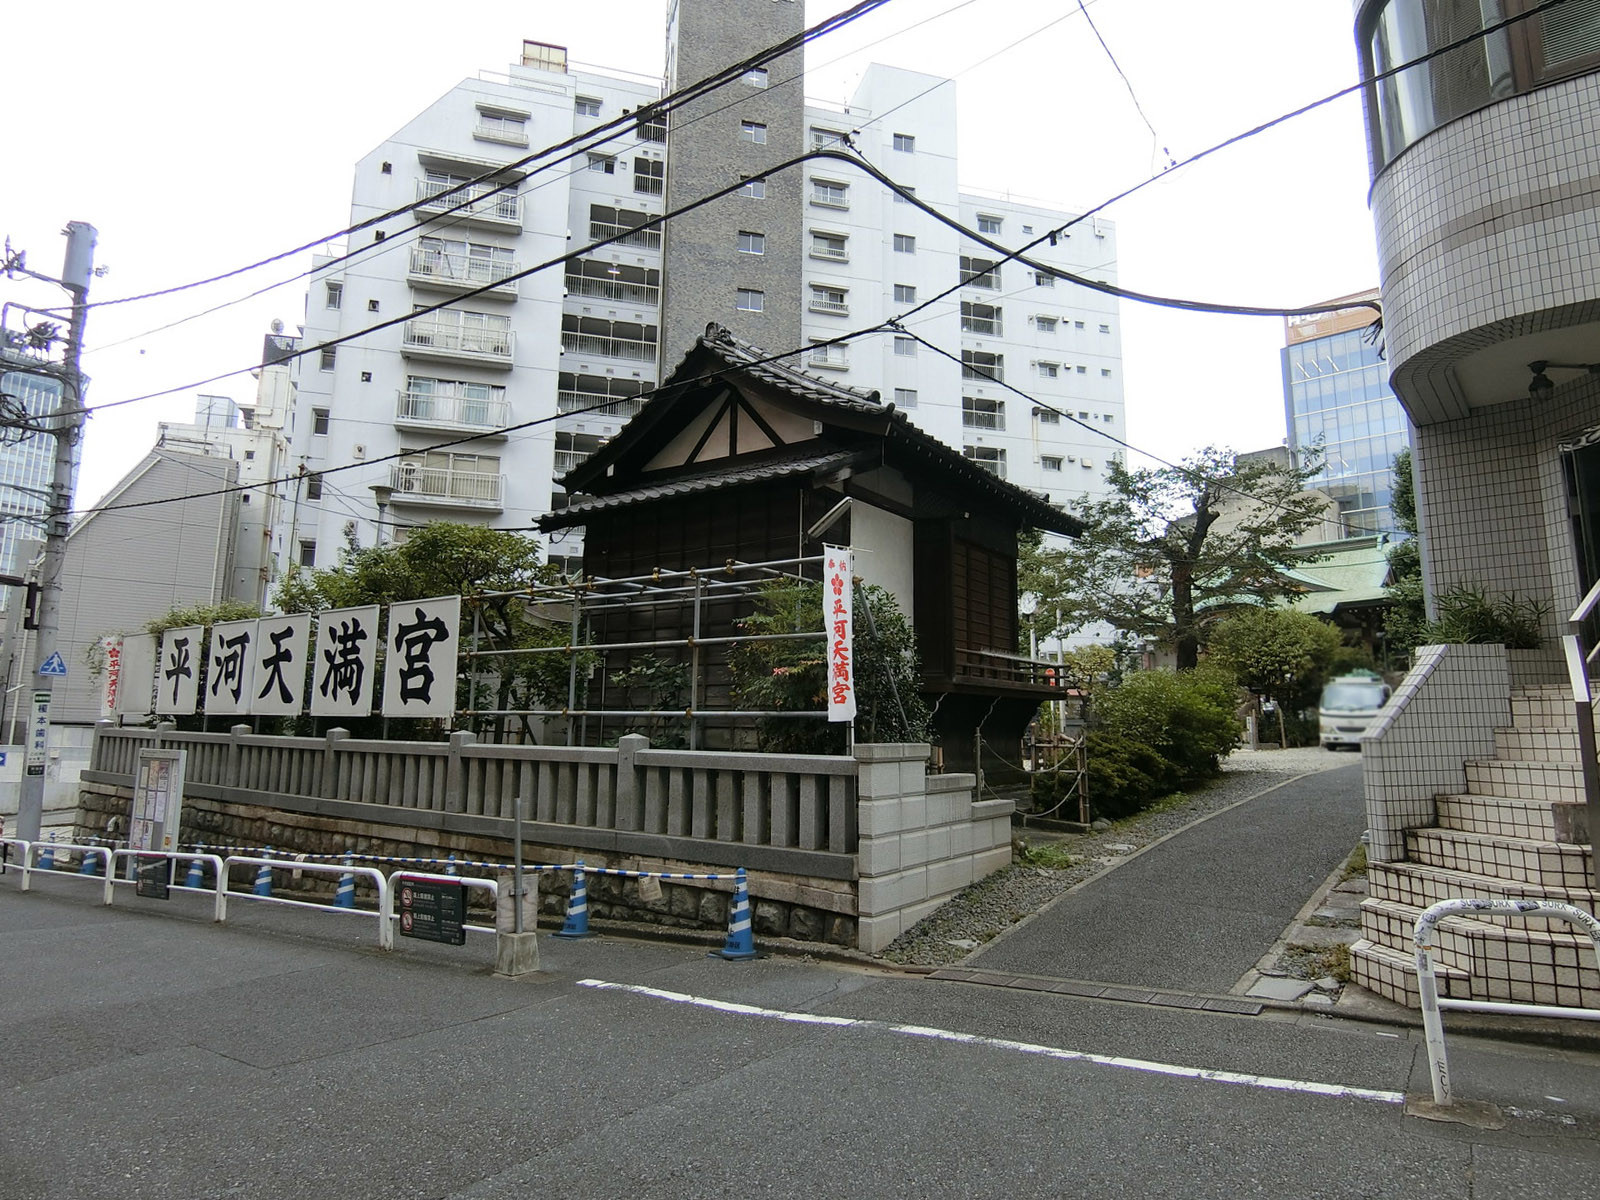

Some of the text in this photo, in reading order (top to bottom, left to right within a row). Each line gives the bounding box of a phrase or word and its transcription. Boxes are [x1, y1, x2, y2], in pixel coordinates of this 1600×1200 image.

[165, 607, 450, 706] 平河天満宮
[1572, 909, 1595, 929] SURX
